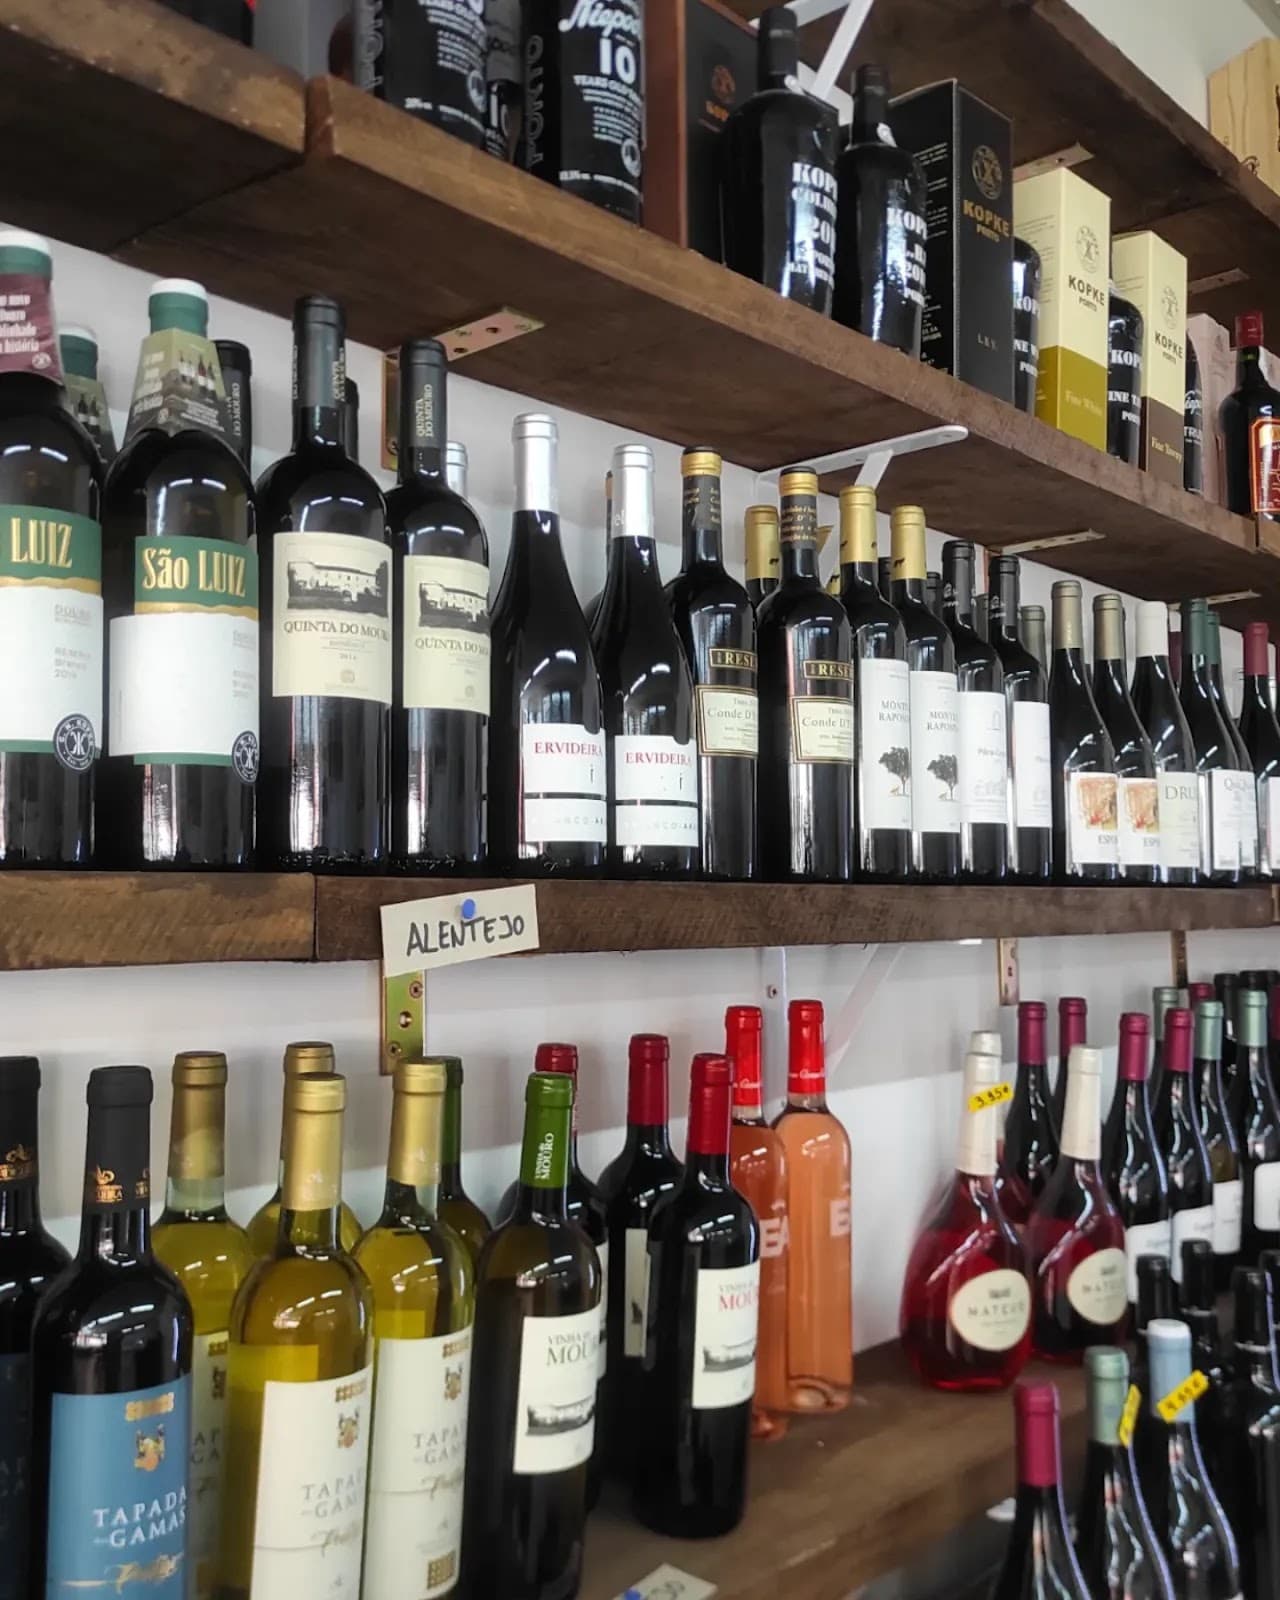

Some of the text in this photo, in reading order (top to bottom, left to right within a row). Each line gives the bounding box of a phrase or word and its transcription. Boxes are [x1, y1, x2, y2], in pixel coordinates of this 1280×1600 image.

[600, 38, 637, 84] 10
[963, 200, 1010, 237] KOPKE
[1068, 274, 1105, 306] KOPKE
[1154, 331, 1183, 359] KOPKE
[11, 517, 73, 568] LUIZ
[142, 547, 247, 598] São LUIZ
[283, 620, 338, 635] QUINTA
[340, 623, 360, 635] DO
[414, 637, 463, 652] QUINTA
[464, 643, 478, 654] DO
[706, 706, 744, 719] Conde
[801, 717, 837, 729] Conde
[406, 914, 525, 957] ALENTEJO
[540, 1132, 554, 1180] MOURO
[93, 1485, 187, 1528] TAPADA
[110, 1505, 186, 1547] GAMAS
